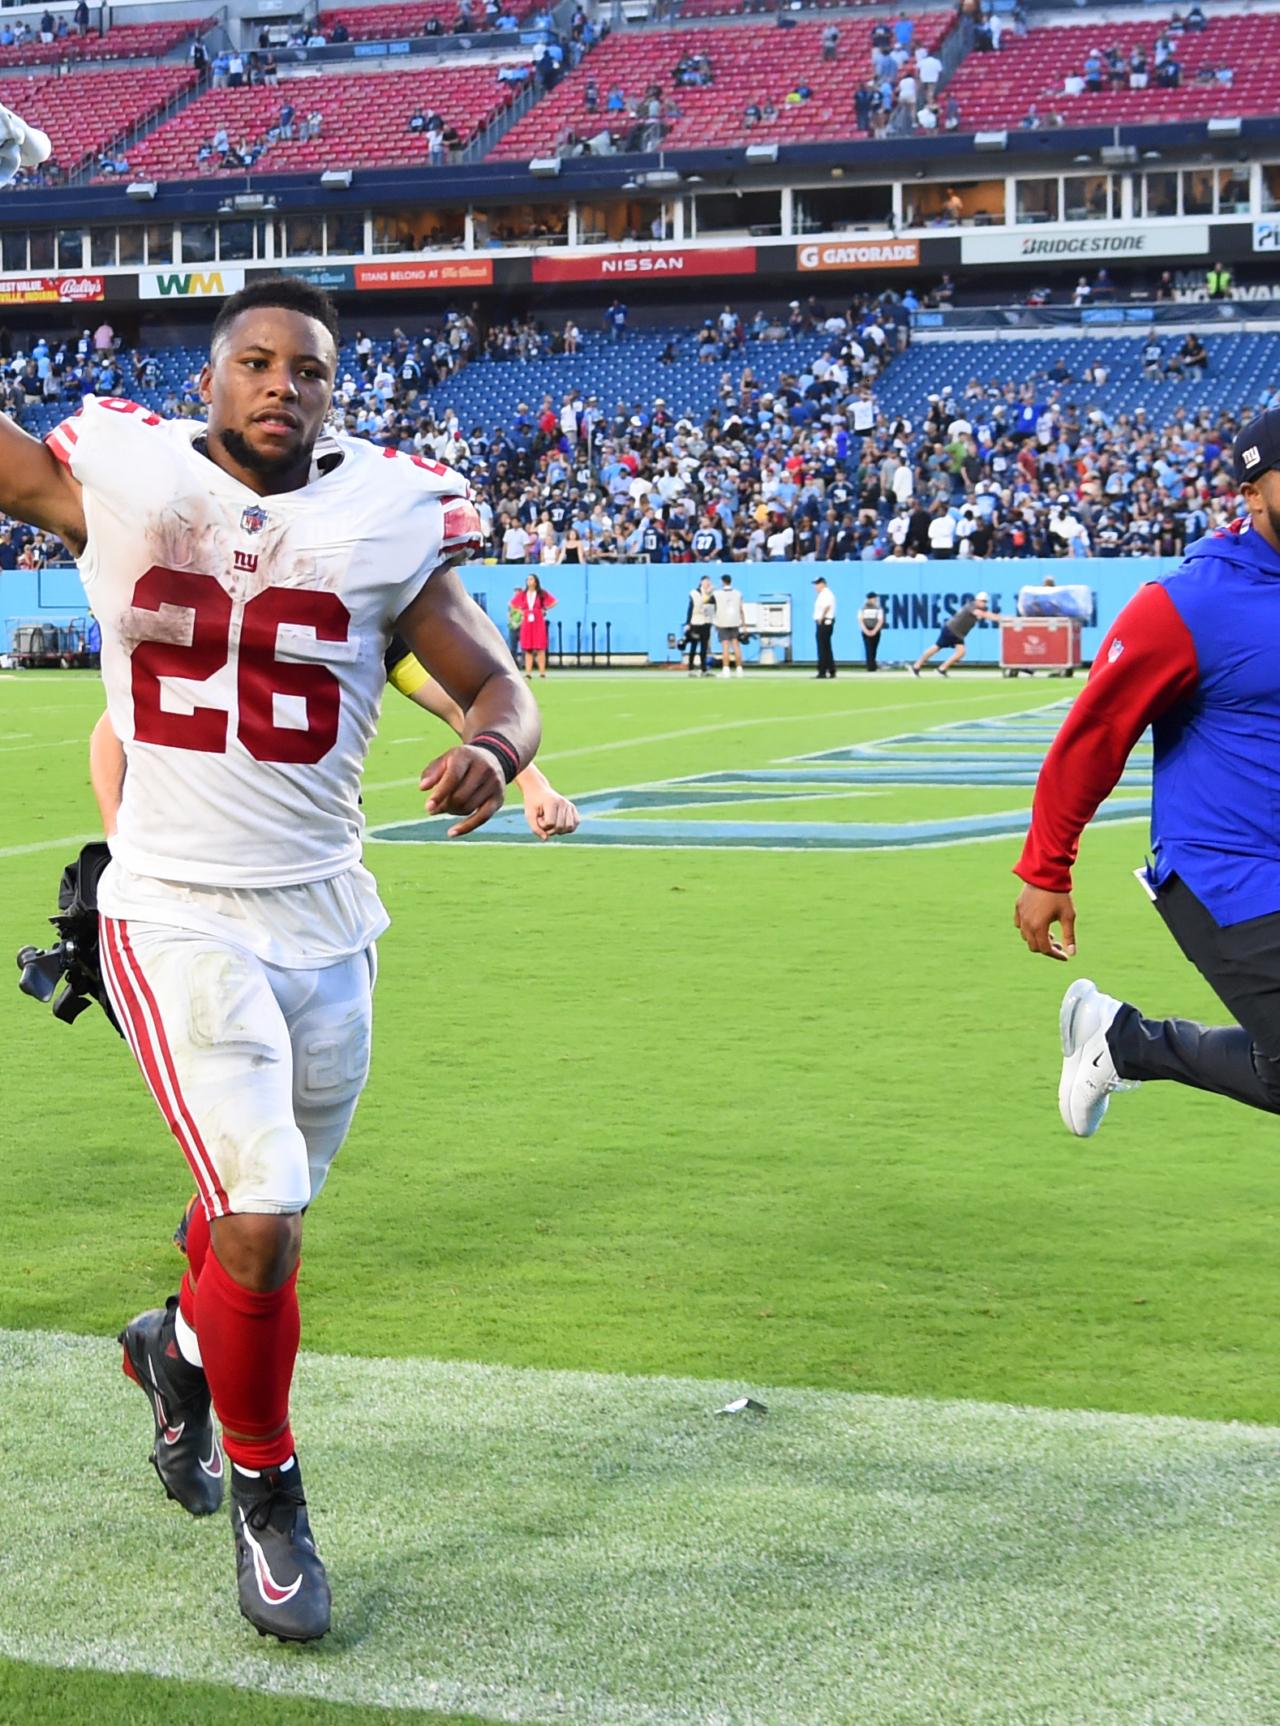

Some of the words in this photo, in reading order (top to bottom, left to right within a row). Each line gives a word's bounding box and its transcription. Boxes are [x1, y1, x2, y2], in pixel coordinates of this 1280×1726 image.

[823, 245, 916, 264] GATORADE
[1022, 235, 1147, 255] BRIDGESTONE
[602, 257, 683, 272] NISSAN
[156, 272, 225, 295] WM
[390, 270, 426, 280] BELONG
[428, 269, 438, 279] AT
[60, 278, 101, 297] Bally's
[130, 565, 351, 765] 26
